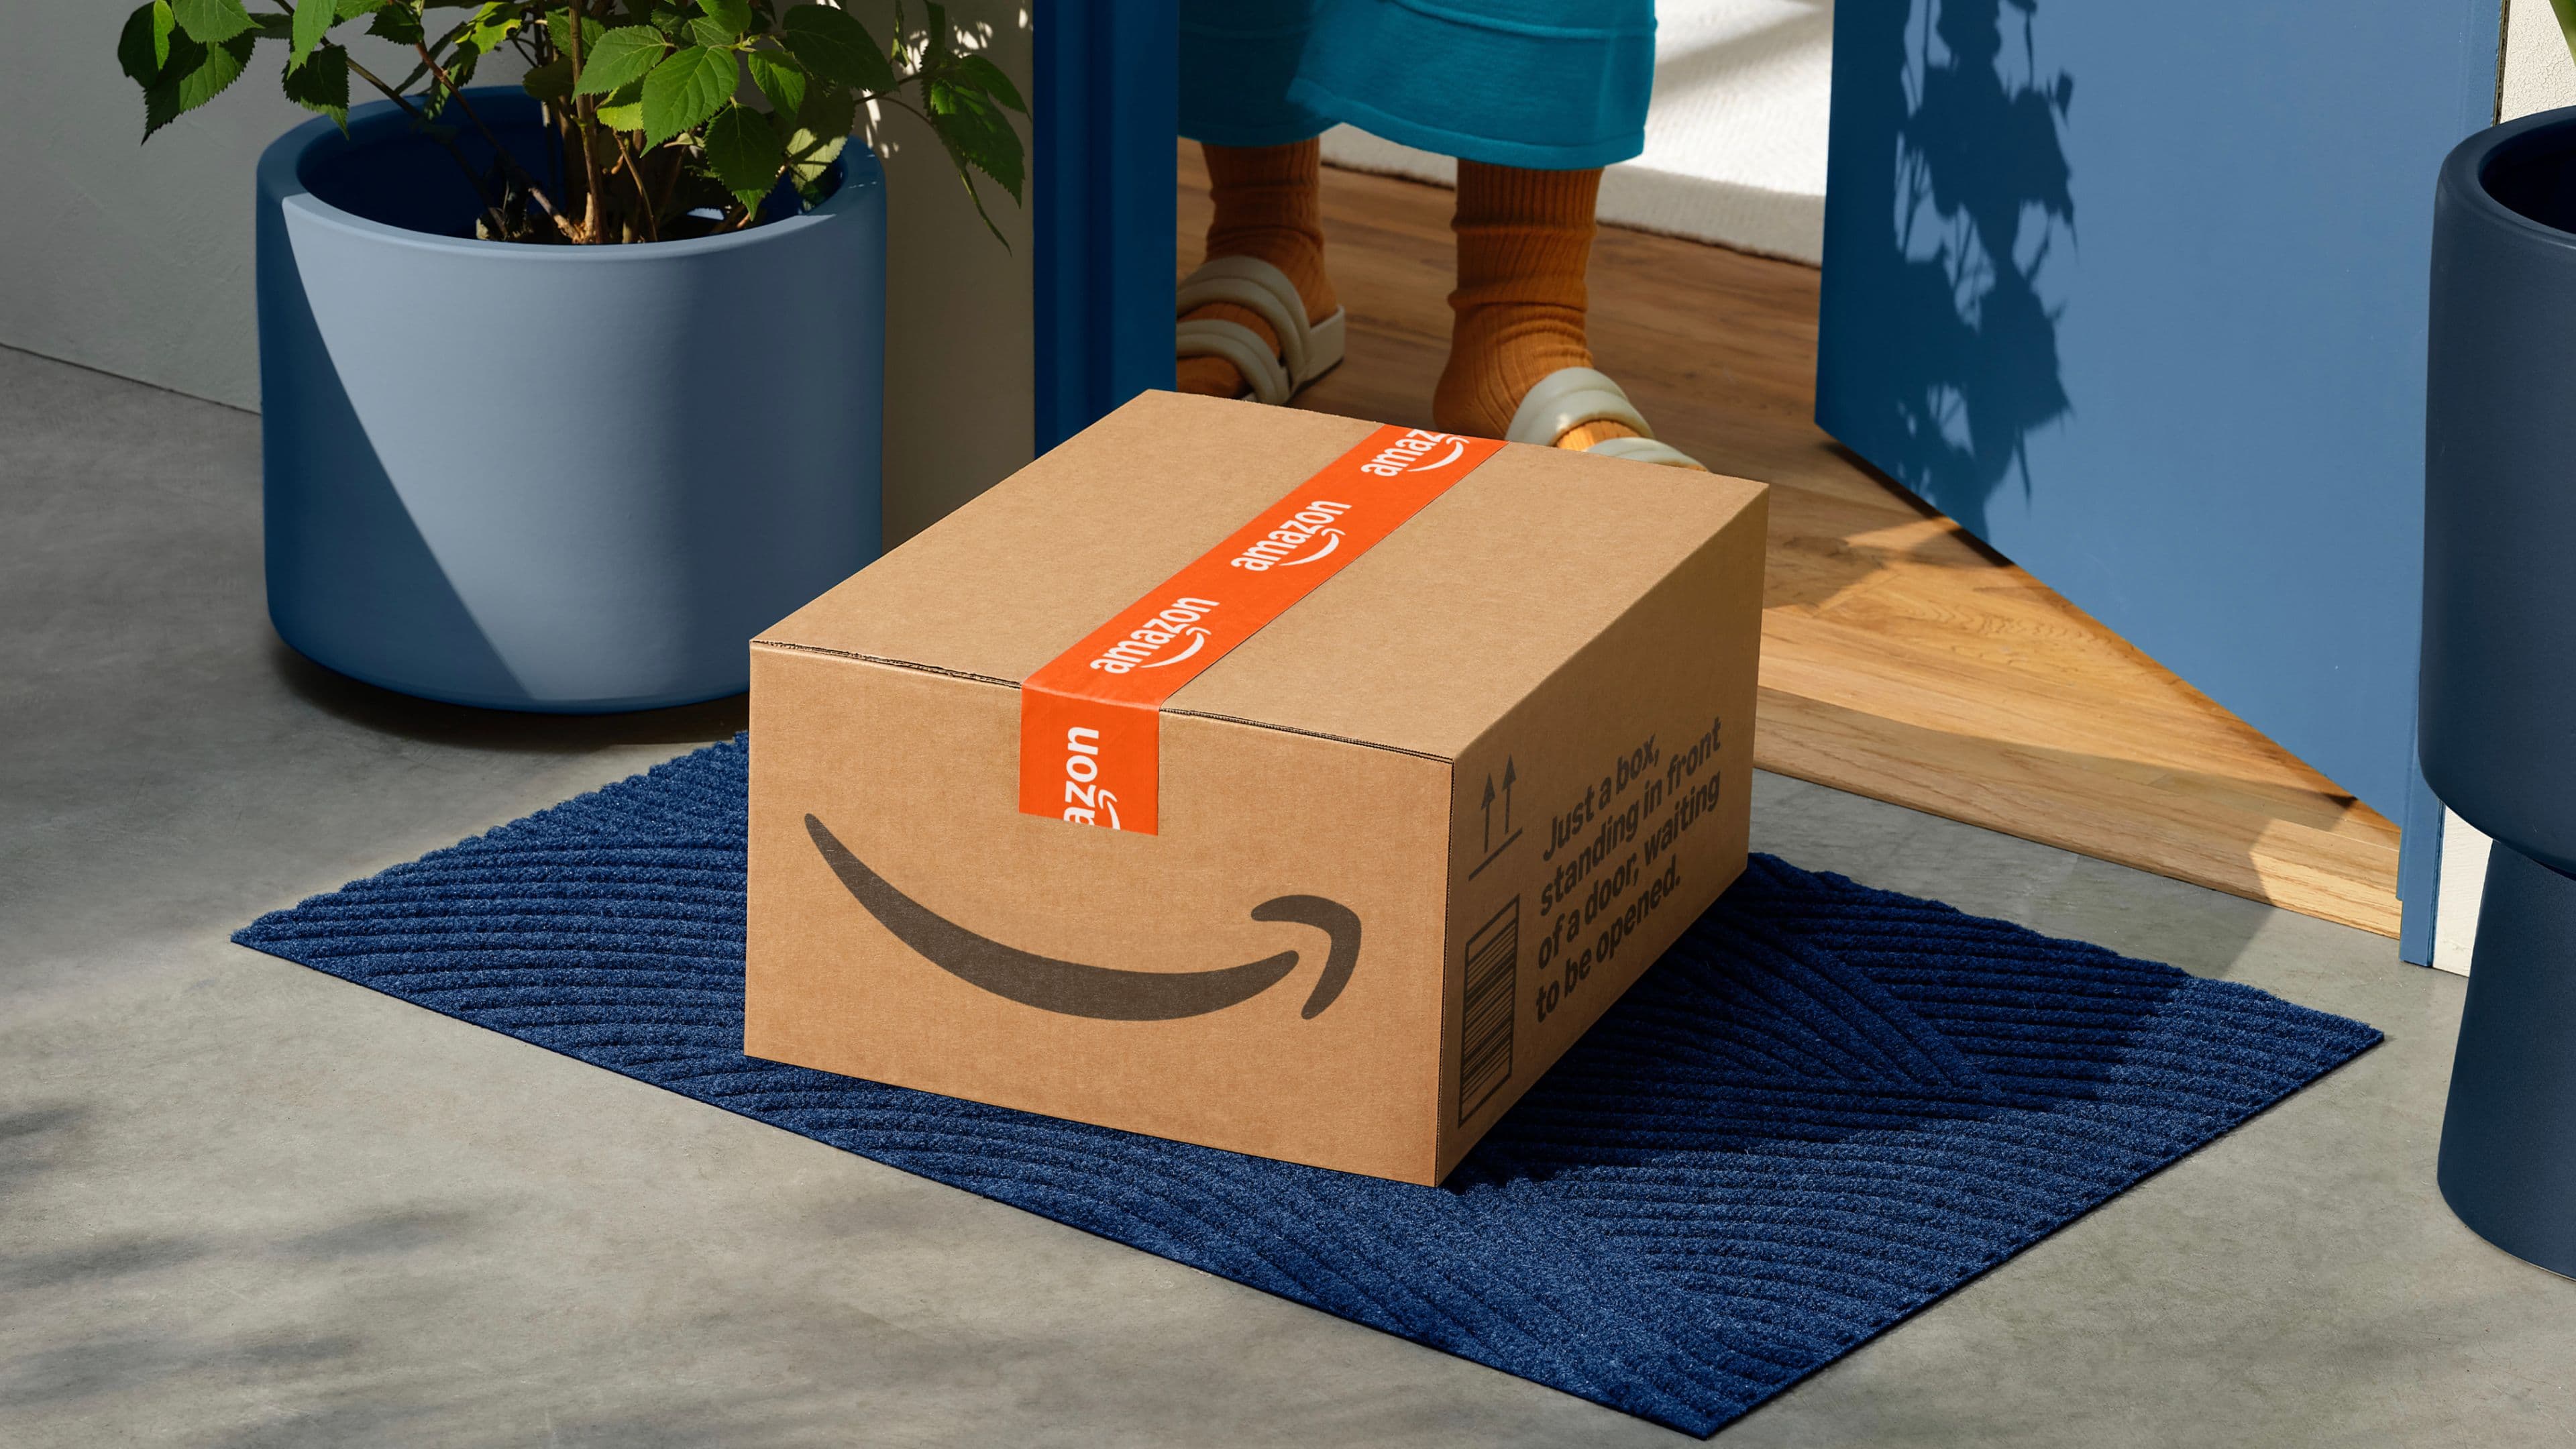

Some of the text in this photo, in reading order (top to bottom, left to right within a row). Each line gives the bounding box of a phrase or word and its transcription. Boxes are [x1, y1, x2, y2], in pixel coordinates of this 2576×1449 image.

[1360, 429, 1449, 477] amaz
[1230, 500, 1353, 572] amazon
[1089, 597, 1220, 674] amazon
[1540, 716, 1721, 916] standing in front
[1543, 733, 1660, 862] Just a box,
[1538, 770, 1721, 970] of a door, waiting
[1536, 853, 1681, 1023] to be opened.
